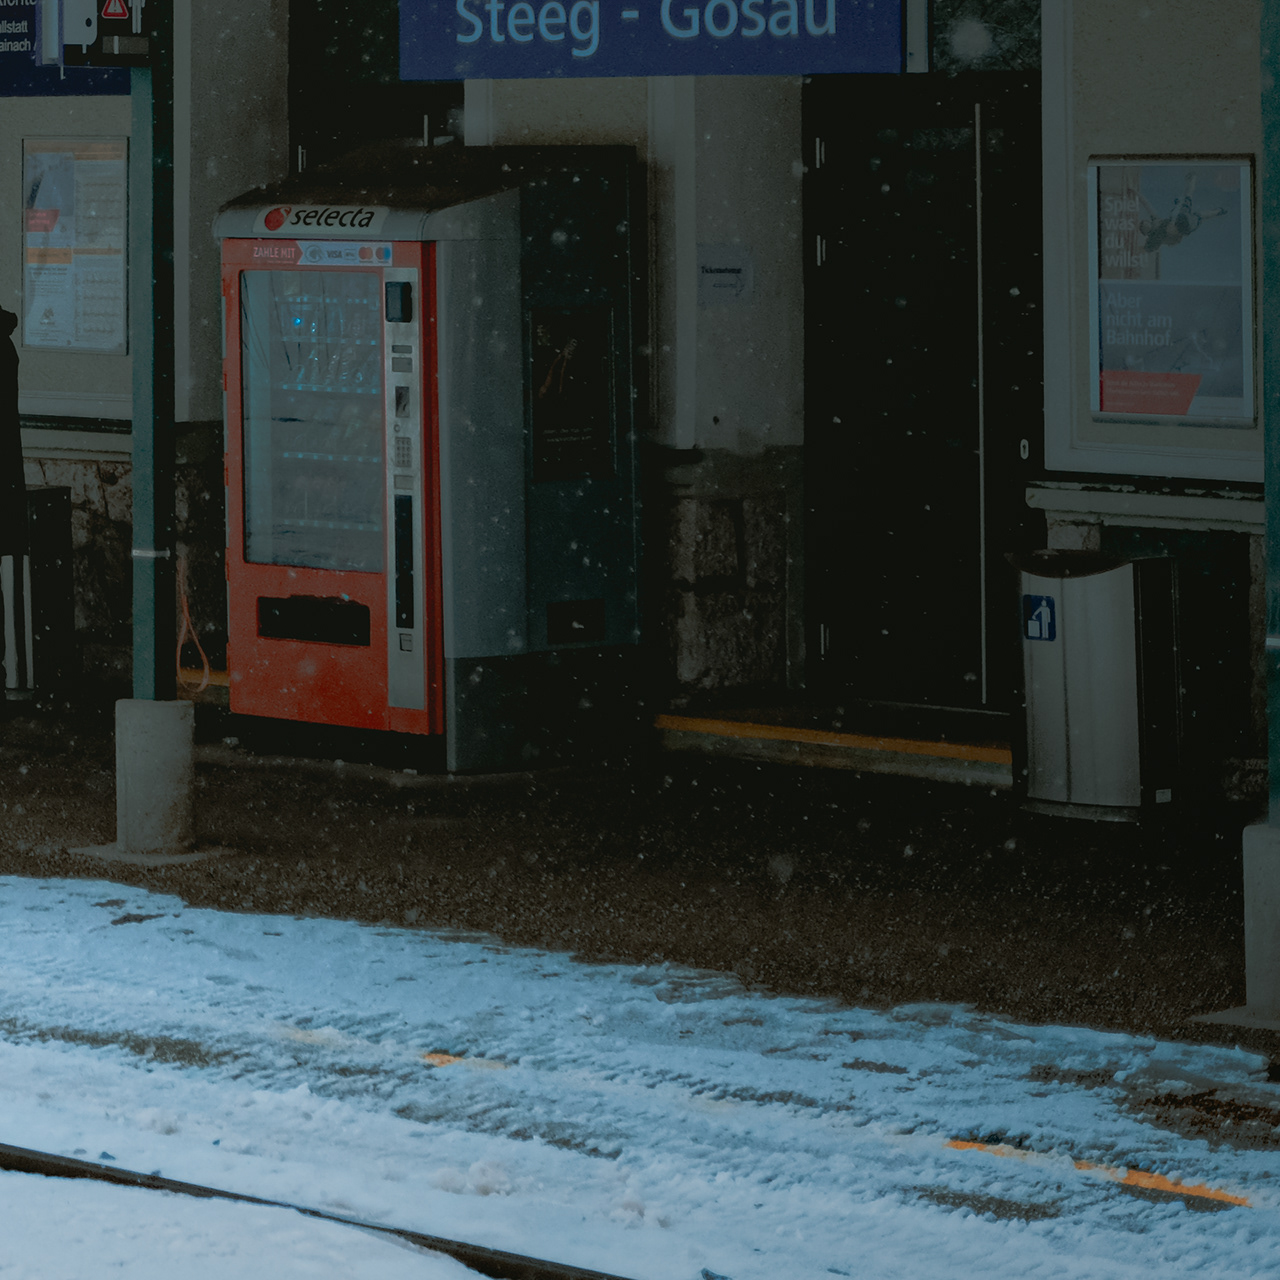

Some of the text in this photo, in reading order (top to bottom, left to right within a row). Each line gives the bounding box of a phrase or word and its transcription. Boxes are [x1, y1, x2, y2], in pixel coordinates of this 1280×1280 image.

[622, 10, 639, 20] -
[1104, 197, 1140, 216] Spiel
[290, 207, 375, 228] selecta
[1104, 218, 1135, 231] was
[1104, 234, 1123, 250] du
[281, 247, 296, 258] MIT
[1105, 292, 1143, 308] Aber
[1105, 311, 1173, 328] nicht am
[1106, 330, 1174, 347] Bahnhof.
